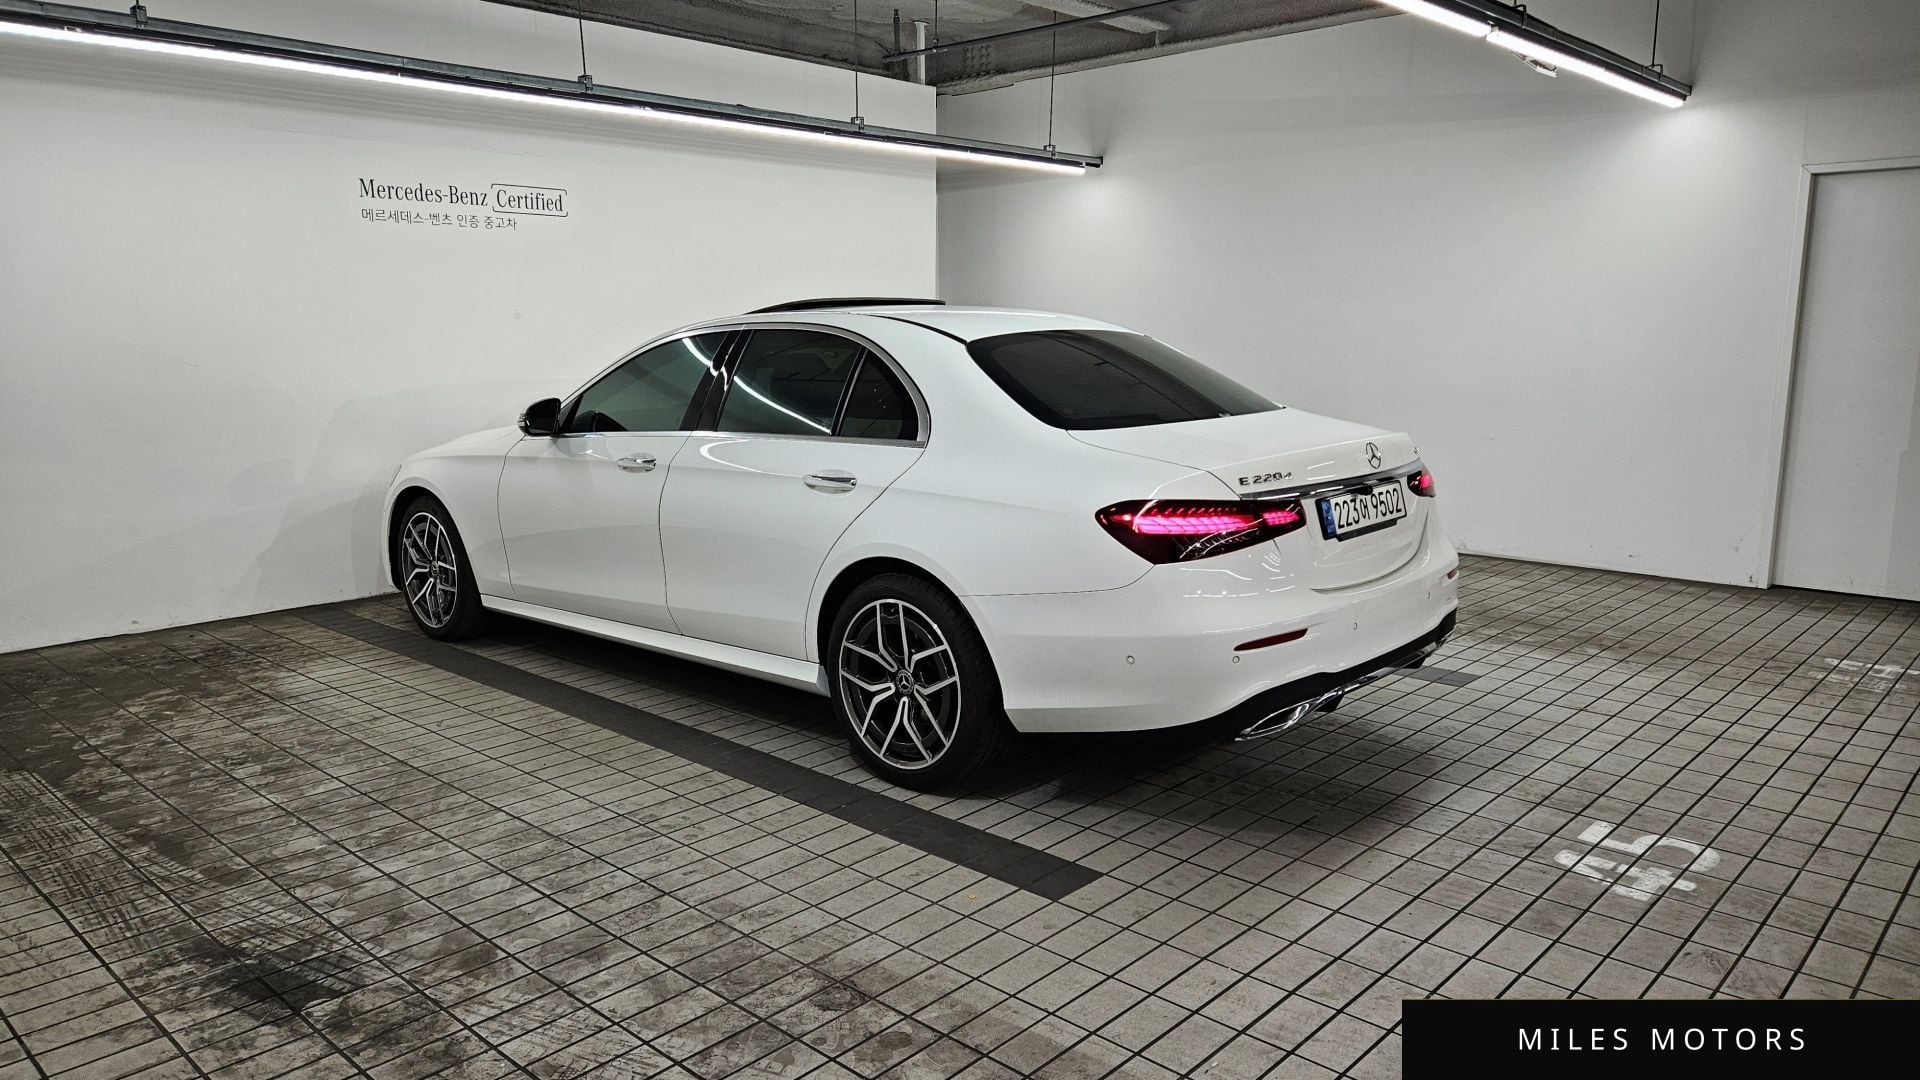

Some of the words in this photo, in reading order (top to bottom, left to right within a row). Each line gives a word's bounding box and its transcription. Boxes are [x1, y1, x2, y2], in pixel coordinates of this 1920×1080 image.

[359, 178, 488, 207] Mercedes-Benz
[496, 189, 563, 212] Certified
[361, 208, 453, 226] 메르세데스-벤츠
[456, 214, 480, 229] 인증
[484, 216, 517, 230] 중고차
[1371, 488, 1402, 519] 9502
[1554, 819, 1721, 901] 45
